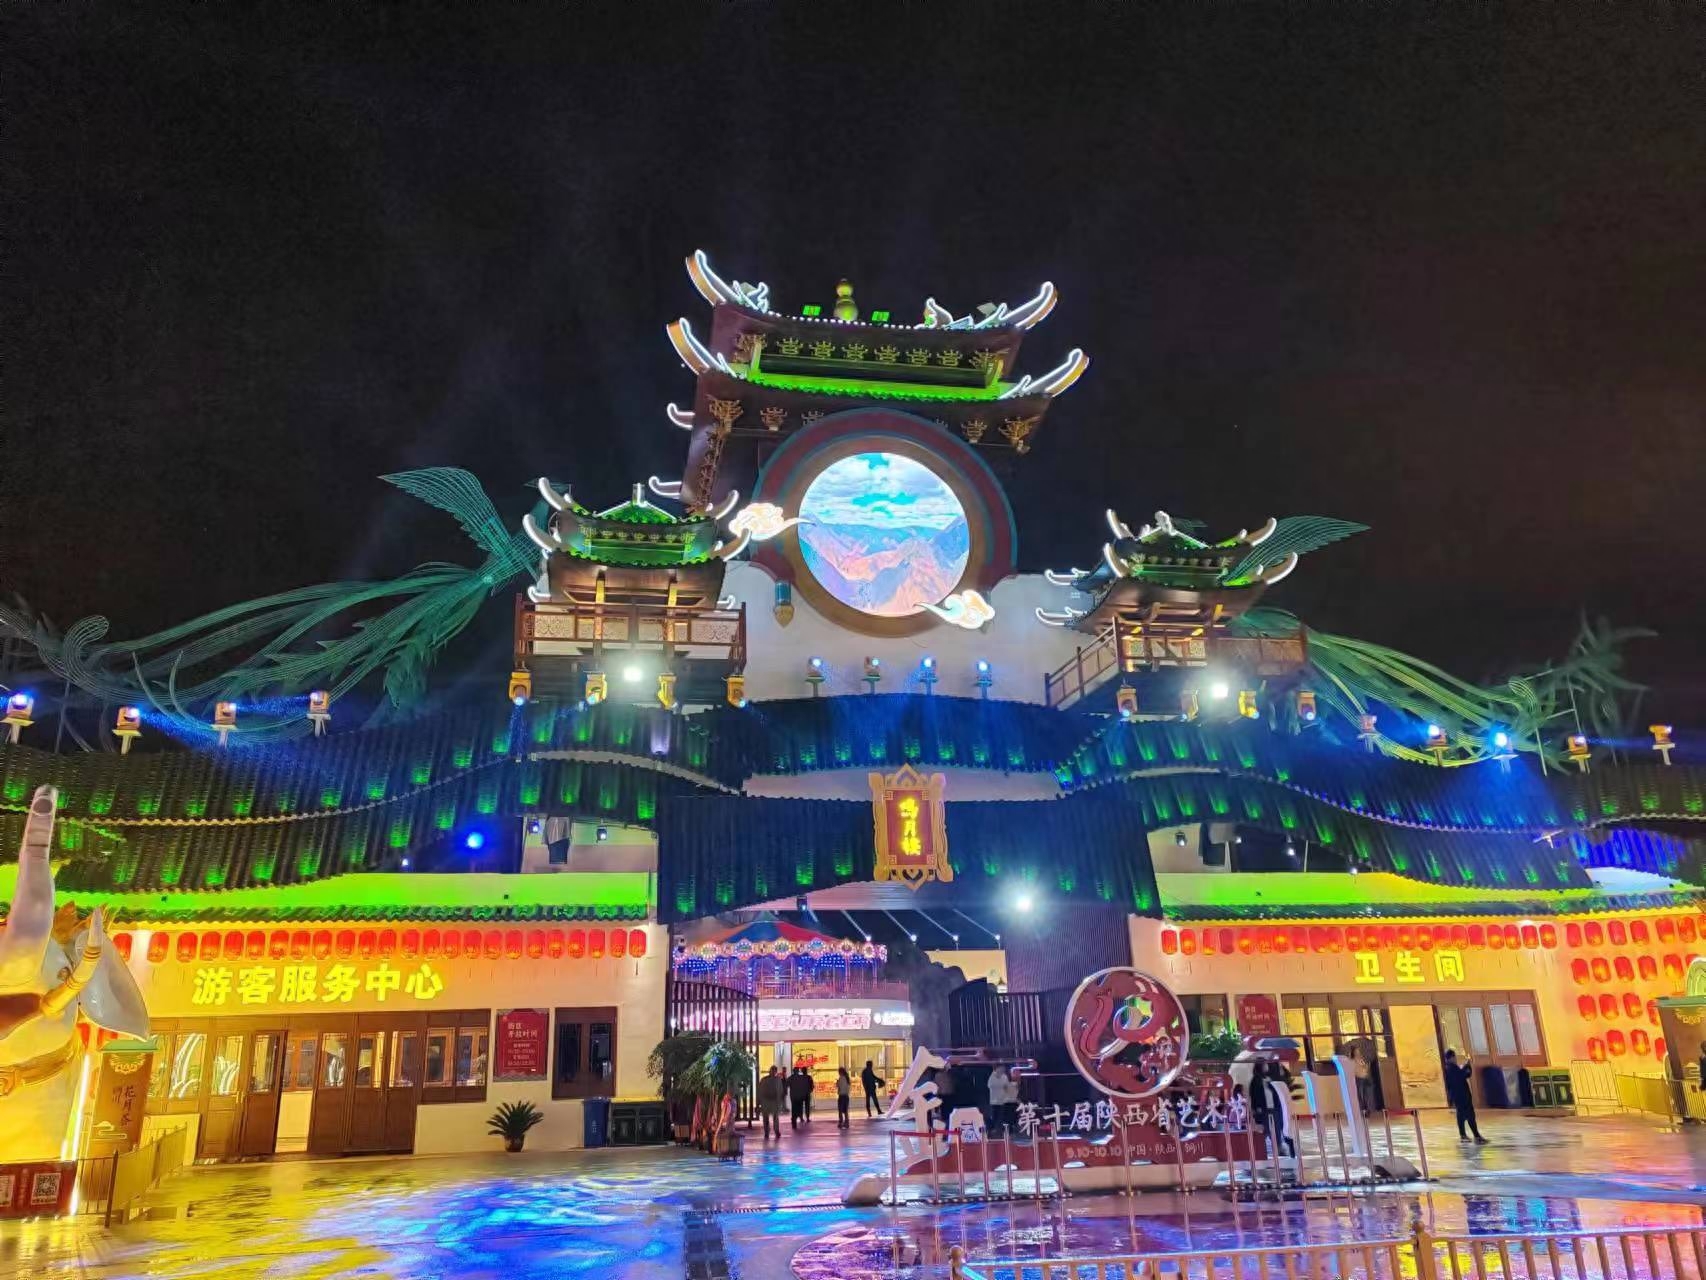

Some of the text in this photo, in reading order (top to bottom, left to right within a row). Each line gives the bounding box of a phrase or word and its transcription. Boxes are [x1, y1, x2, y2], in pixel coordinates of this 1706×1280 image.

[192, 963, 443, 1005] 游客服务中心
[1354, 949, 1465, 984] 卫生间
[1016, 1093, 1248, 1136] 第十届陕西省艺术节
